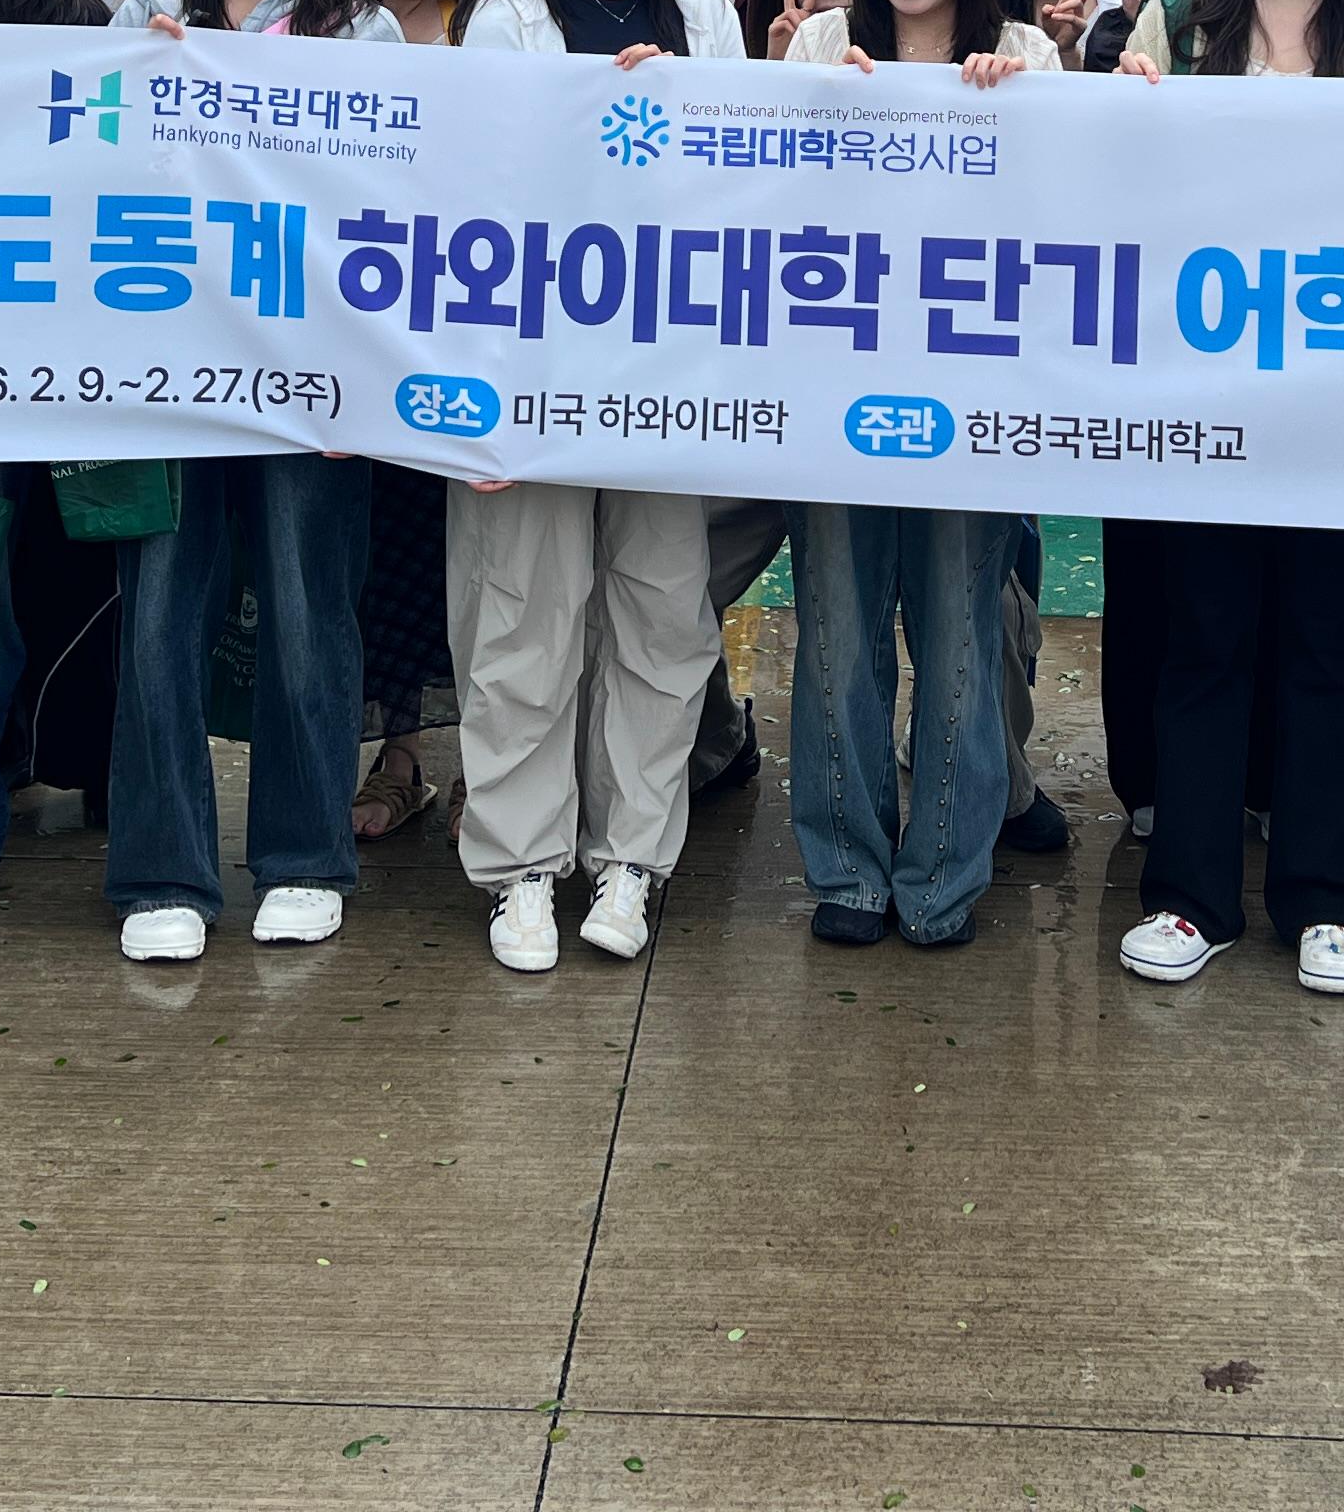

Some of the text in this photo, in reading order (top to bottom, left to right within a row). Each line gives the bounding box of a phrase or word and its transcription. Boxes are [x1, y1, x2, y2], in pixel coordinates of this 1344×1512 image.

[149, 74, 421, 133] 한경국립대학교
[682, 102, 998, 127] Korea National University Development Project
[152, 123, 417, 165] Hankyong National University
[681, 125, 997, 176] 국립대학육성사업
[90, 194, 307, 319] 동계
[337, 208, 891, 352] 하와이대학
[919, 236, 1141, 366] 단기
[407, 383, 789, 445] 장소 미국 하와이대학
[856, 403, 1247, 465] 주관 한경국립대학교
